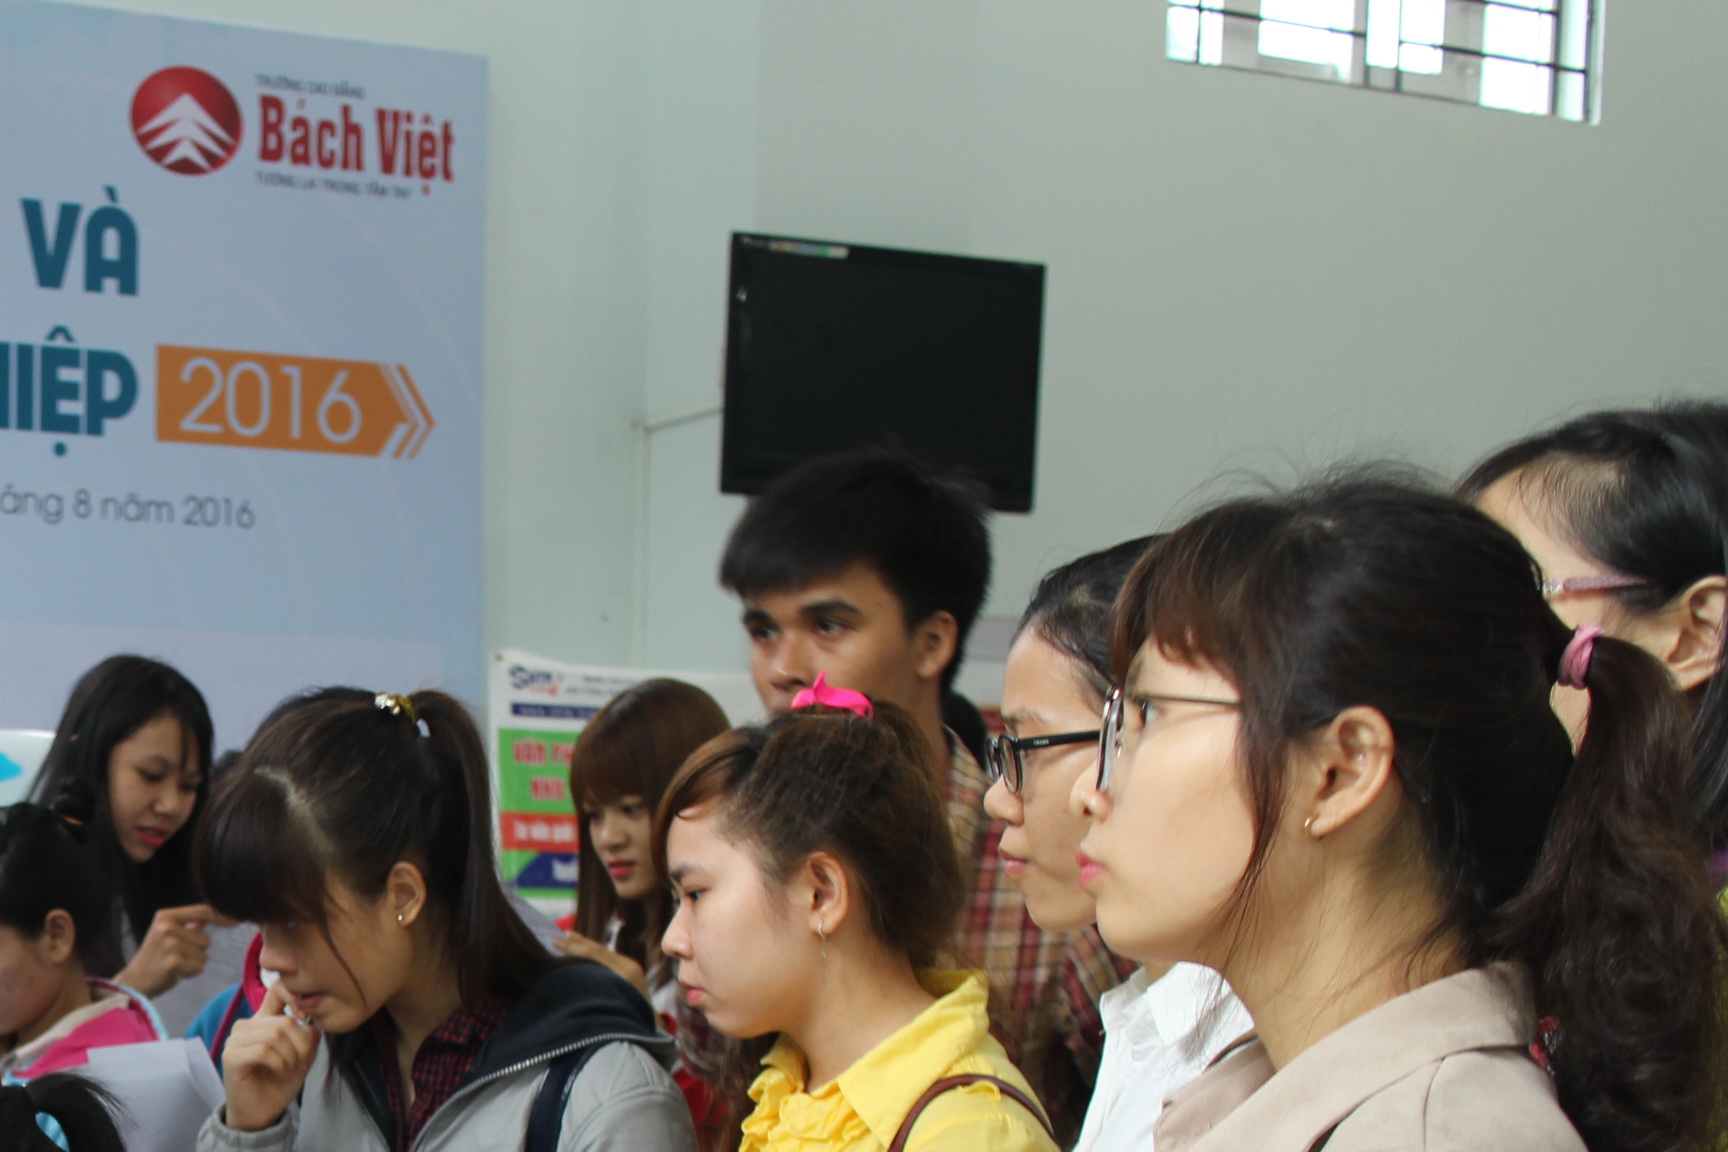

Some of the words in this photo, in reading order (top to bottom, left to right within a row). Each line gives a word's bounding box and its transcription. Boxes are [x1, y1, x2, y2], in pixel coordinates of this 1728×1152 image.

[259, 93, 364, 172] Bách
[376, 107, 453, 196] Việt
[20, 185, 139, 297] VÀ
[179, 357, 363, 444] 2016
[73, 487, 93, 518] 8
[100, 492, 174, 524] năm
[181, 495, 256, 529] 2016
